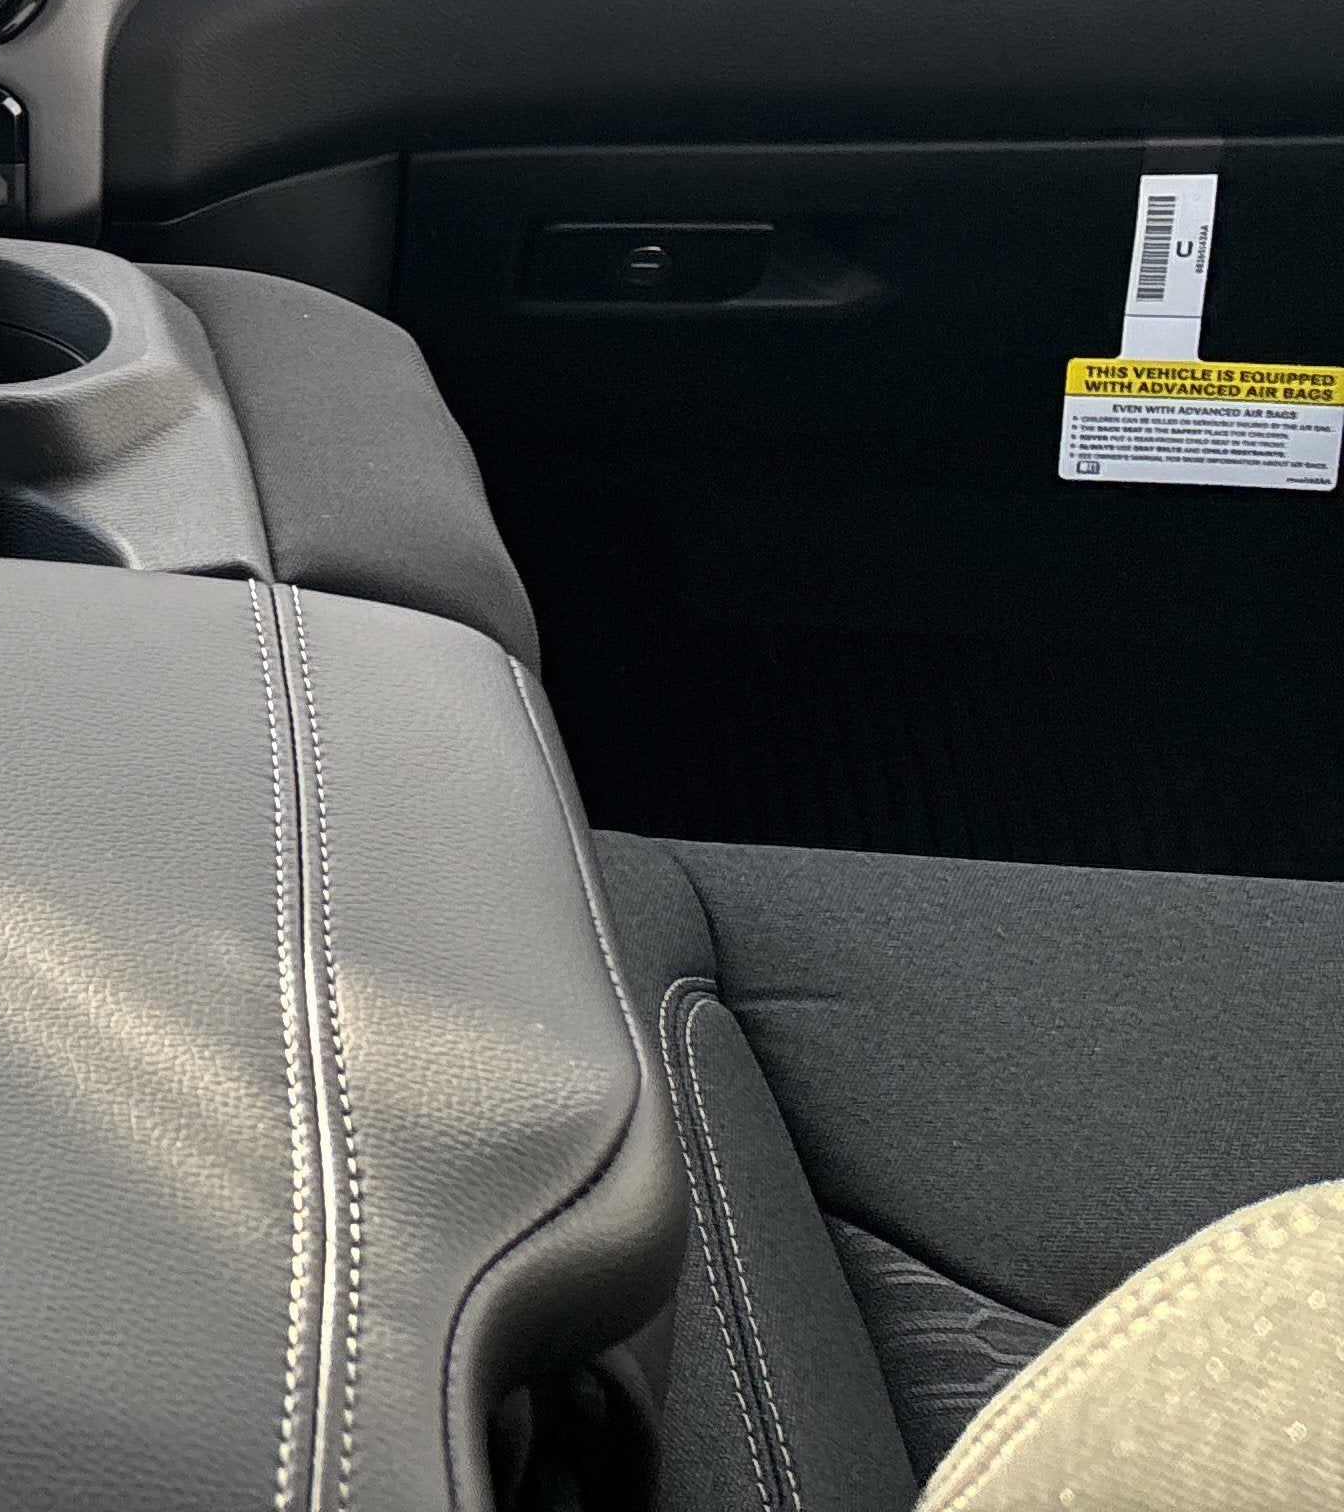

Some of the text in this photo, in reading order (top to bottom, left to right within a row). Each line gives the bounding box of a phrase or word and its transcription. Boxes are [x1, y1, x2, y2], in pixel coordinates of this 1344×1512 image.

[1176, 240, 1194, 257] U
[1086, 365, 1336, 387] THIS VEHICLE IS EQUIPPED
[1084, 380, 1333, 401] WITH ADVANCED AIR BAGS
[1112, 404, 1297, 420] EVEN WITH ADVANCED AIR BAGS
